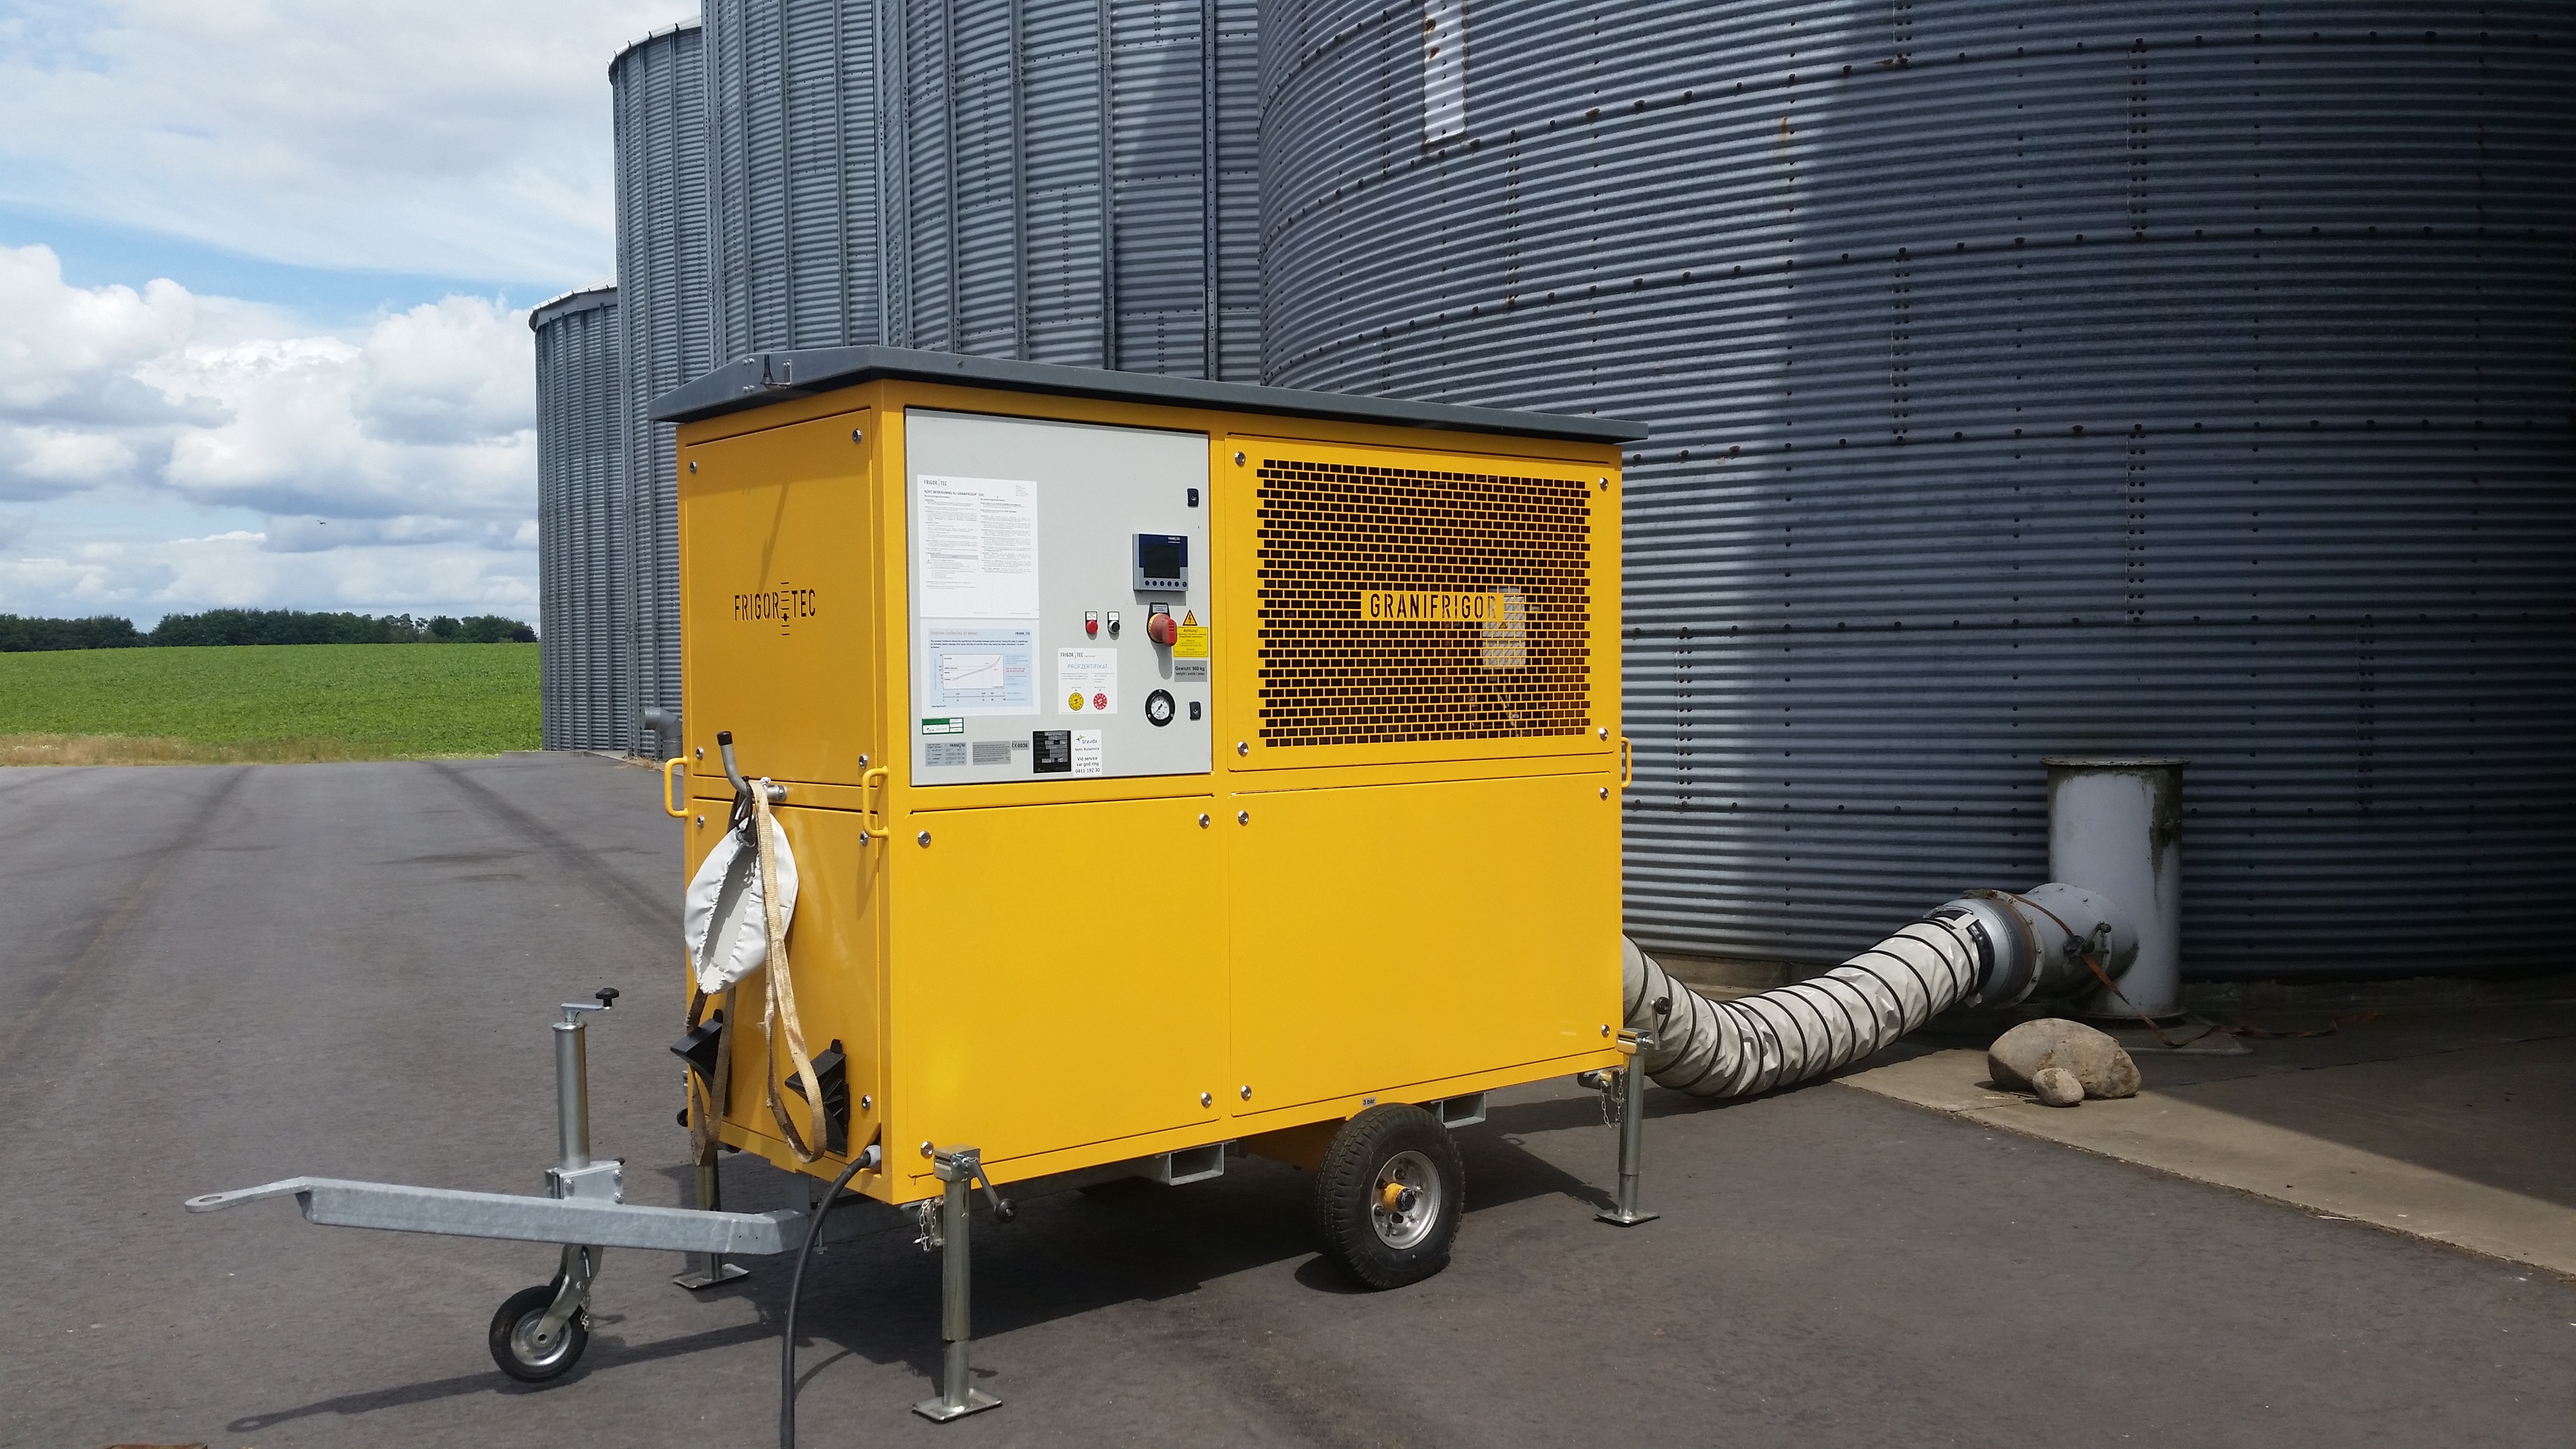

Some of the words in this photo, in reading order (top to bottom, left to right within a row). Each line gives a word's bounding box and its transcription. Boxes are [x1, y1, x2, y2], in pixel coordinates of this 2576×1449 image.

[734, 592, 780, 622] FRIGOR
[791, 588, 816, 618] TEC
[1370, 593, 1497, 619] GRANIFRIGOR
